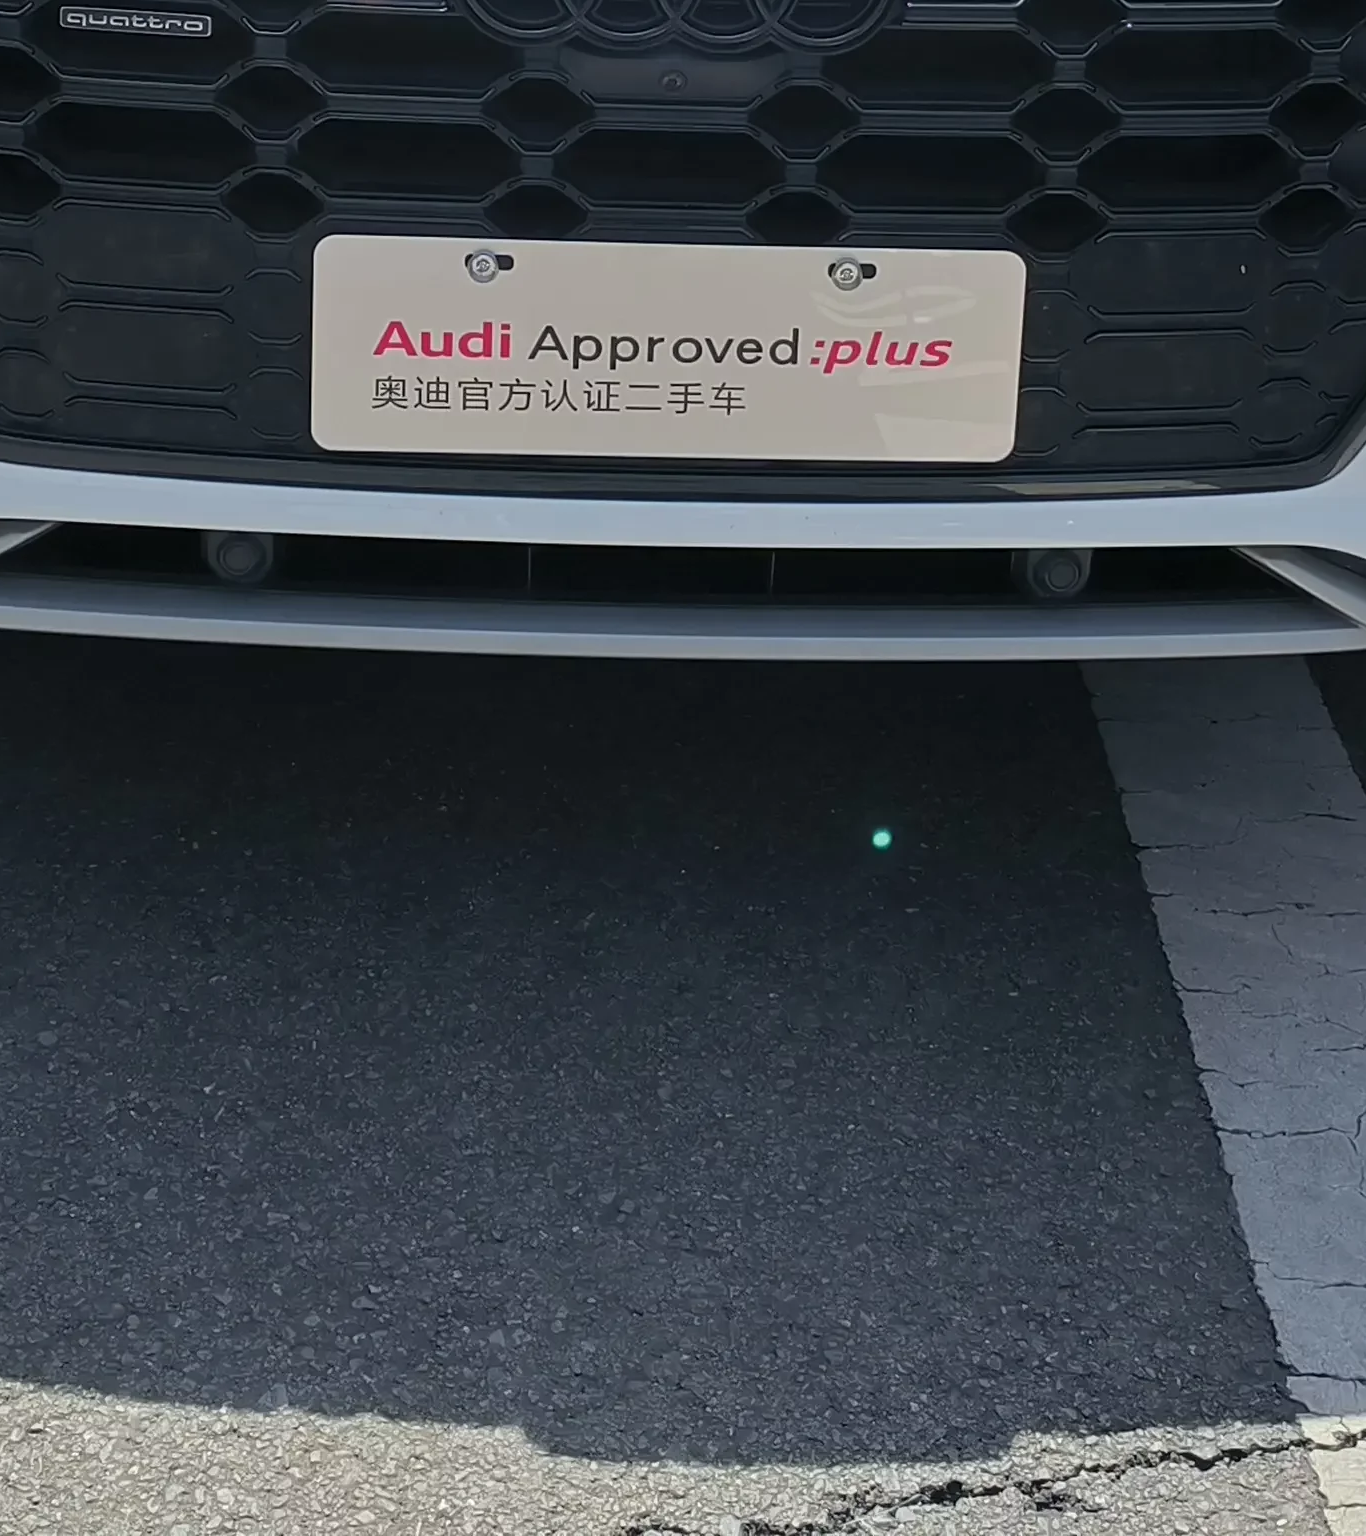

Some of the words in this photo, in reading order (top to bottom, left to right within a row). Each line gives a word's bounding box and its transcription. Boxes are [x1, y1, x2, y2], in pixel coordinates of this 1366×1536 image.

[66, 13, 204, 32] quattro
[373, 321, 511, 359] Audi
[371, 375, 747, 416] 奥迪官方认证二手车
